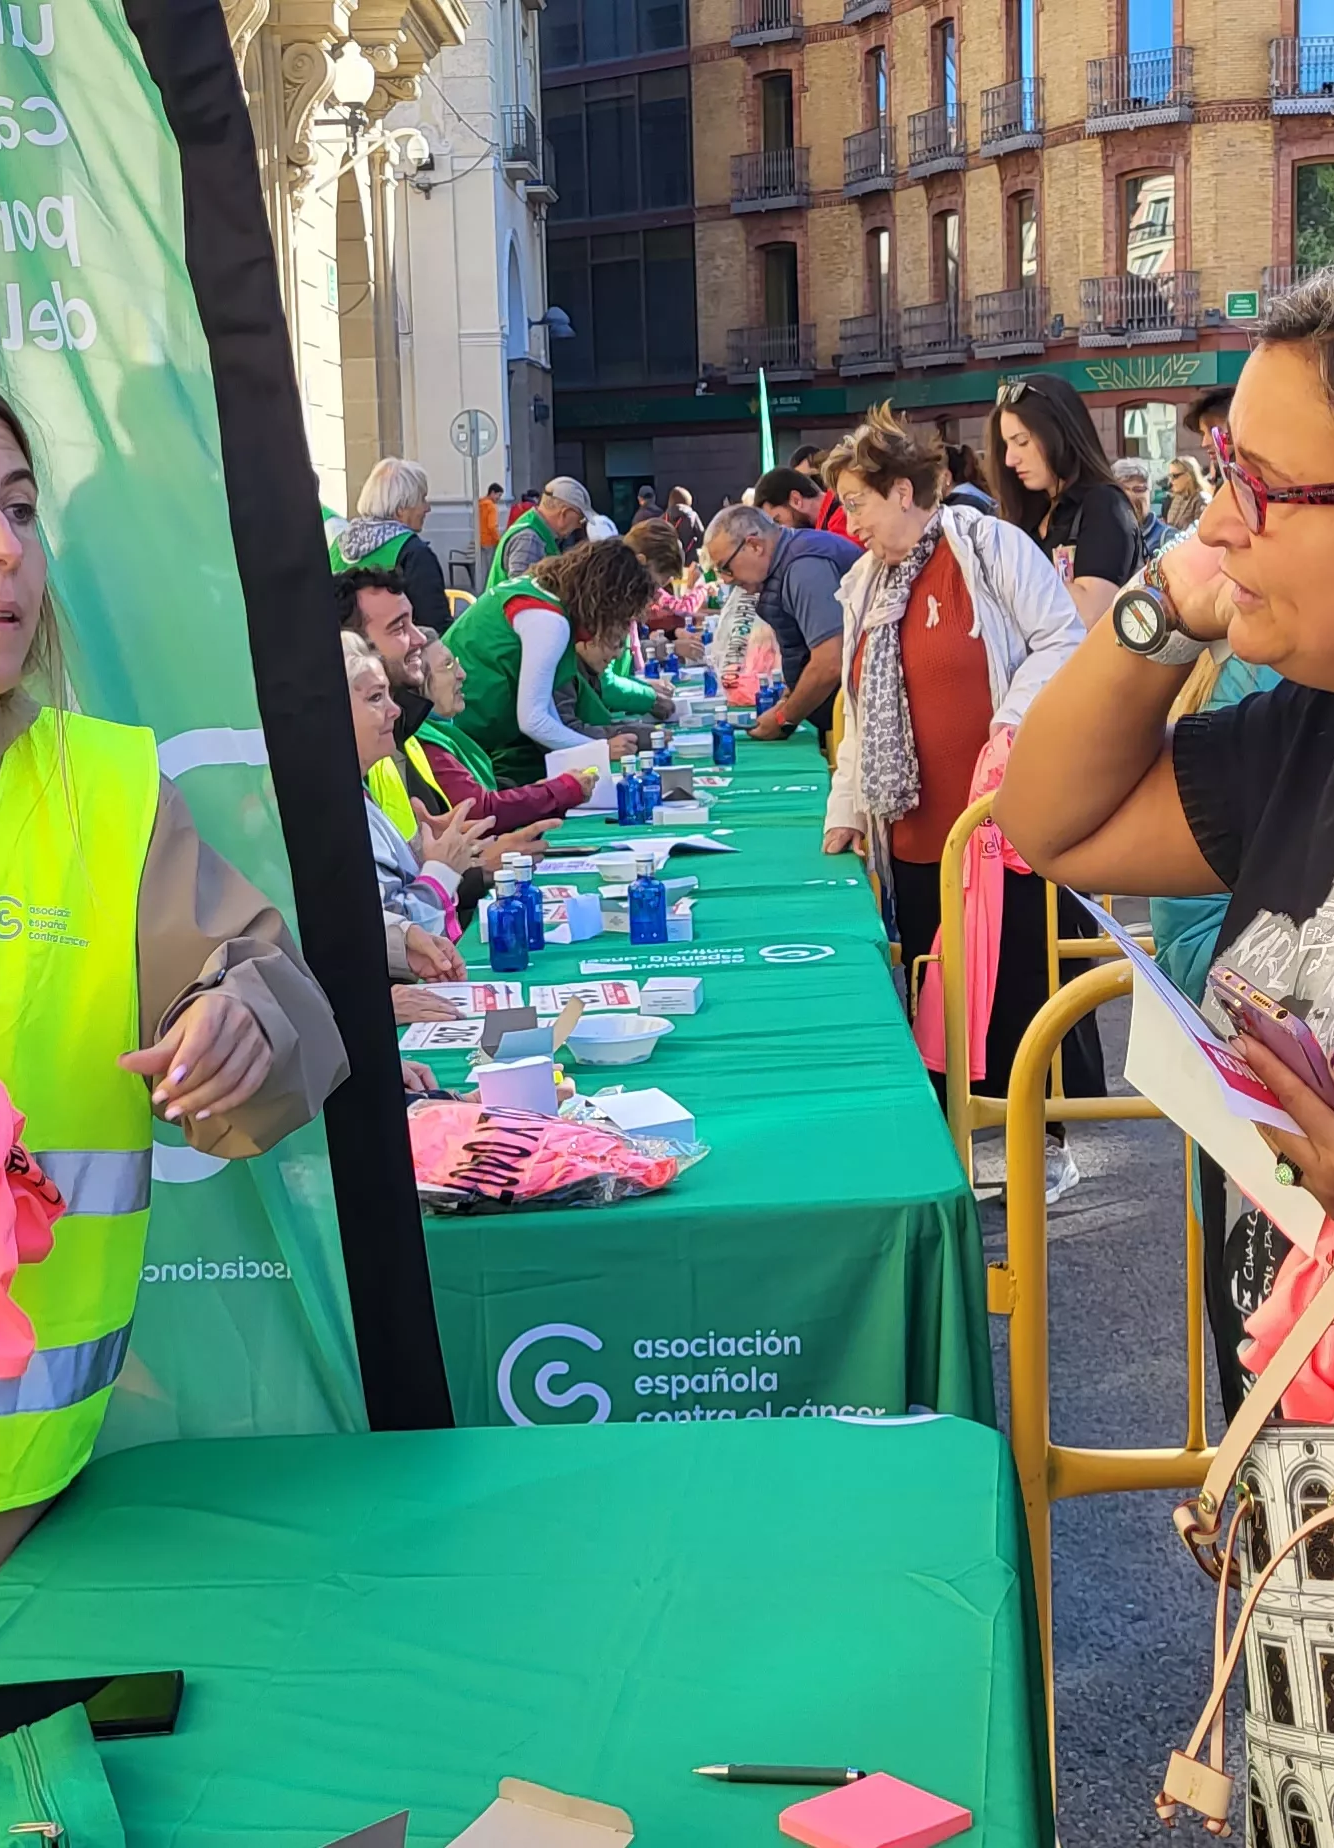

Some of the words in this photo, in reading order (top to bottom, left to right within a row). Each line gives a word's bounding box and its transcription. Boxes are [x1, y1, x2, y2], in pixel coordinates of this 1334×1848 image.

[429, 1025, 480, 1044] 206
[633, 1329, 802, 1359] asociación
[634, 1366, 779, 1401] española
